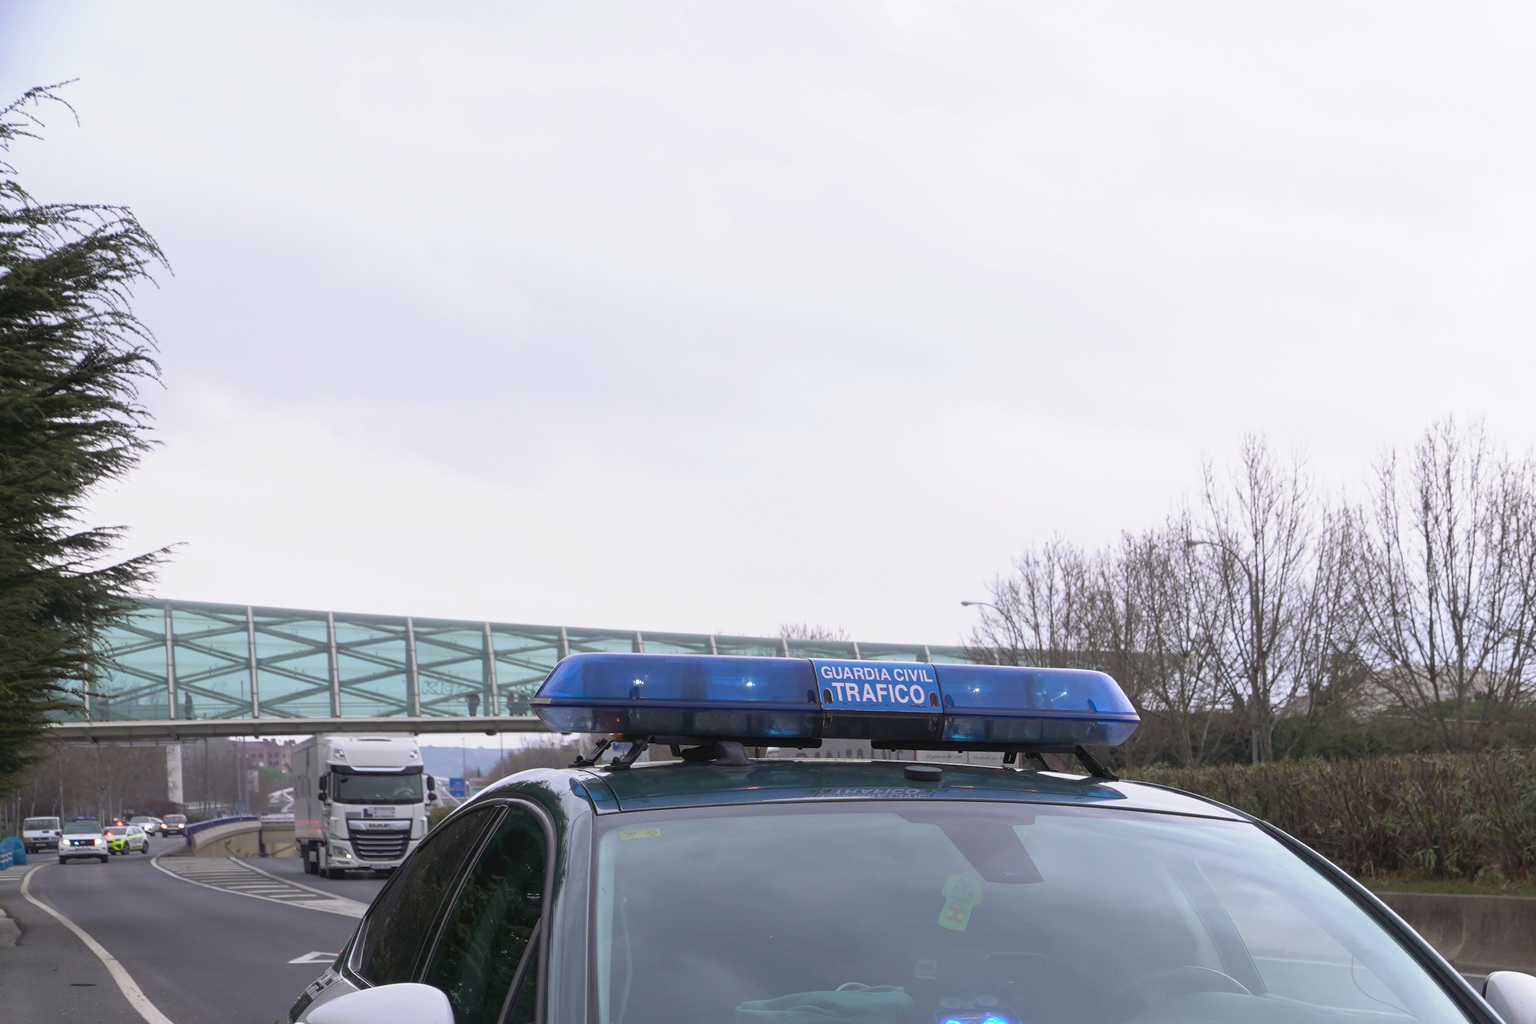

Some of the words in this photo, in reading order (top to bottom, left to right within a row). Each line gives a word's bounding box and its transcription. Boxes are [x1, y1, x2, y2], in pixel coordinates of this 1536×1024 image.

[821, 666, 891, 681] GUARDIA
[893, 668, 933, 682] CIVIL
[831, 682, 925, 704] TRAFICO
